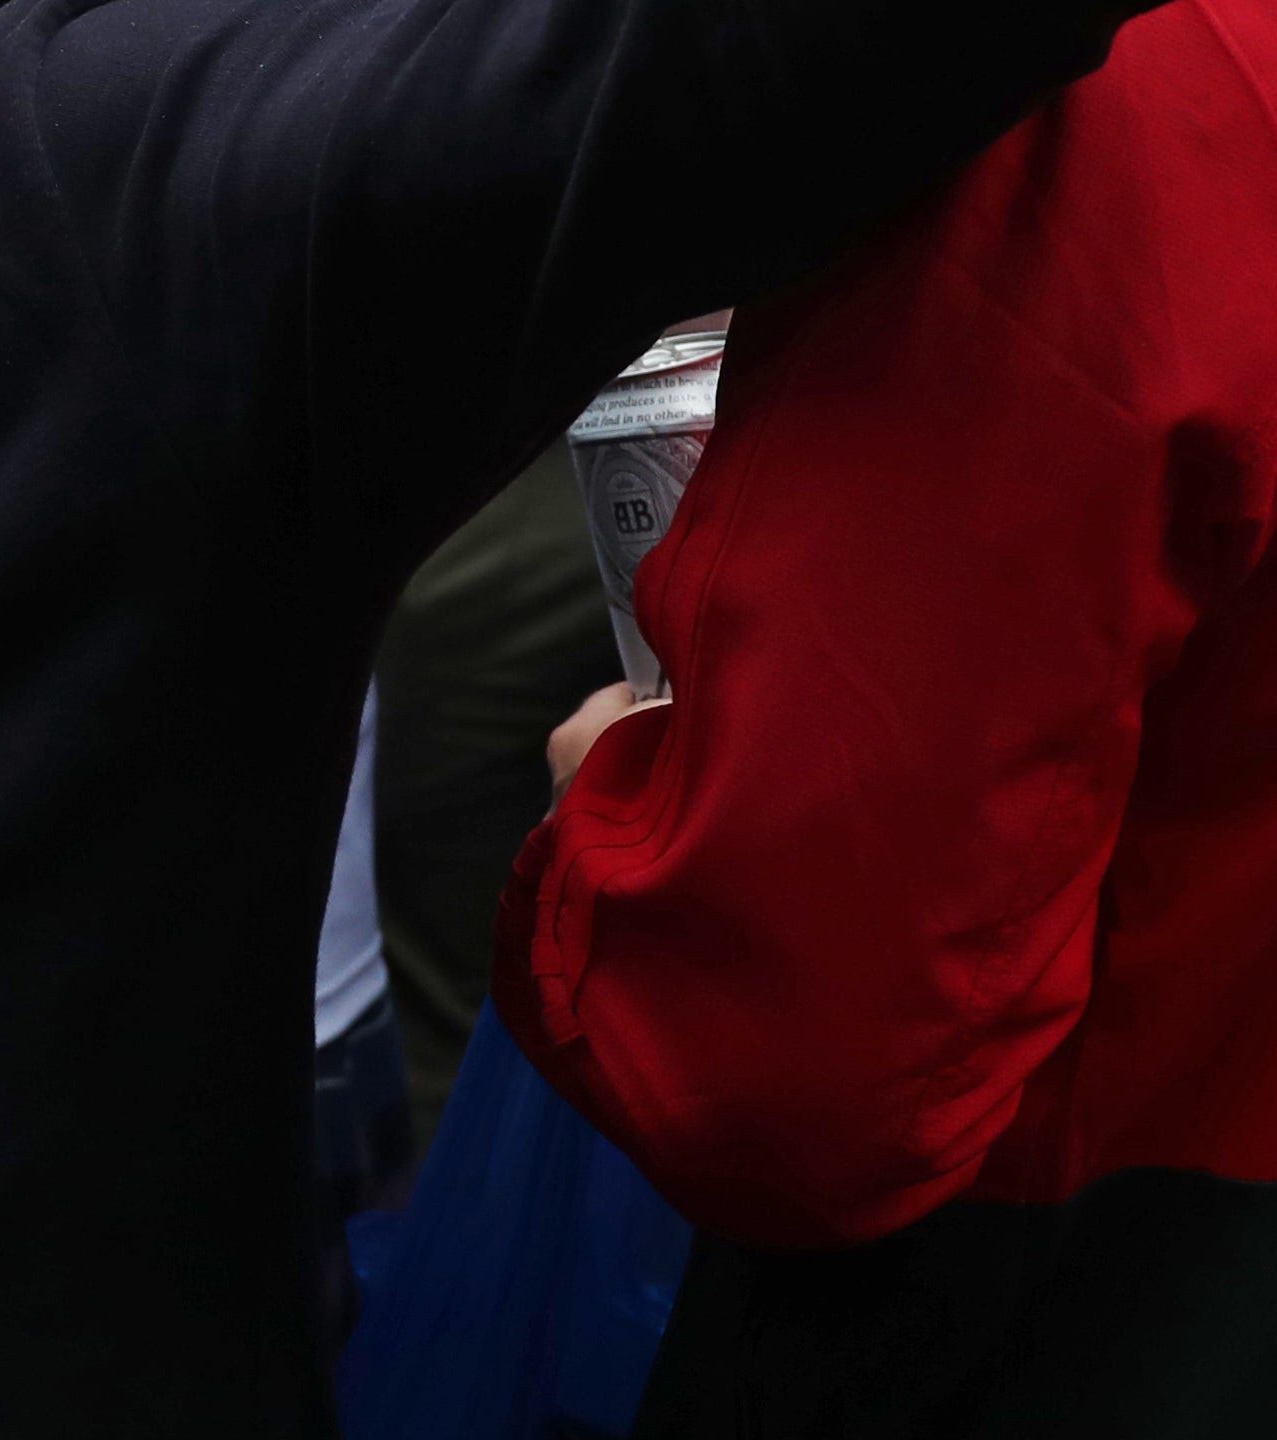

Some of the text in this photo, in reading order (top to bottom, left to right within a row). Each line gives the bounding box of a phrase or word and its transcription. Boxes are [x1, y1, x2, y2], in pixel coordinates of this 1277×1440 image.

[665, 377, 676, 388] to
[608, 396, 655, 411] produces
[658, 397, 666, 405] a
[622, 413, 634, 425] in
[637, 412, 651, 423] no
[655, 408, 686, 421] other
